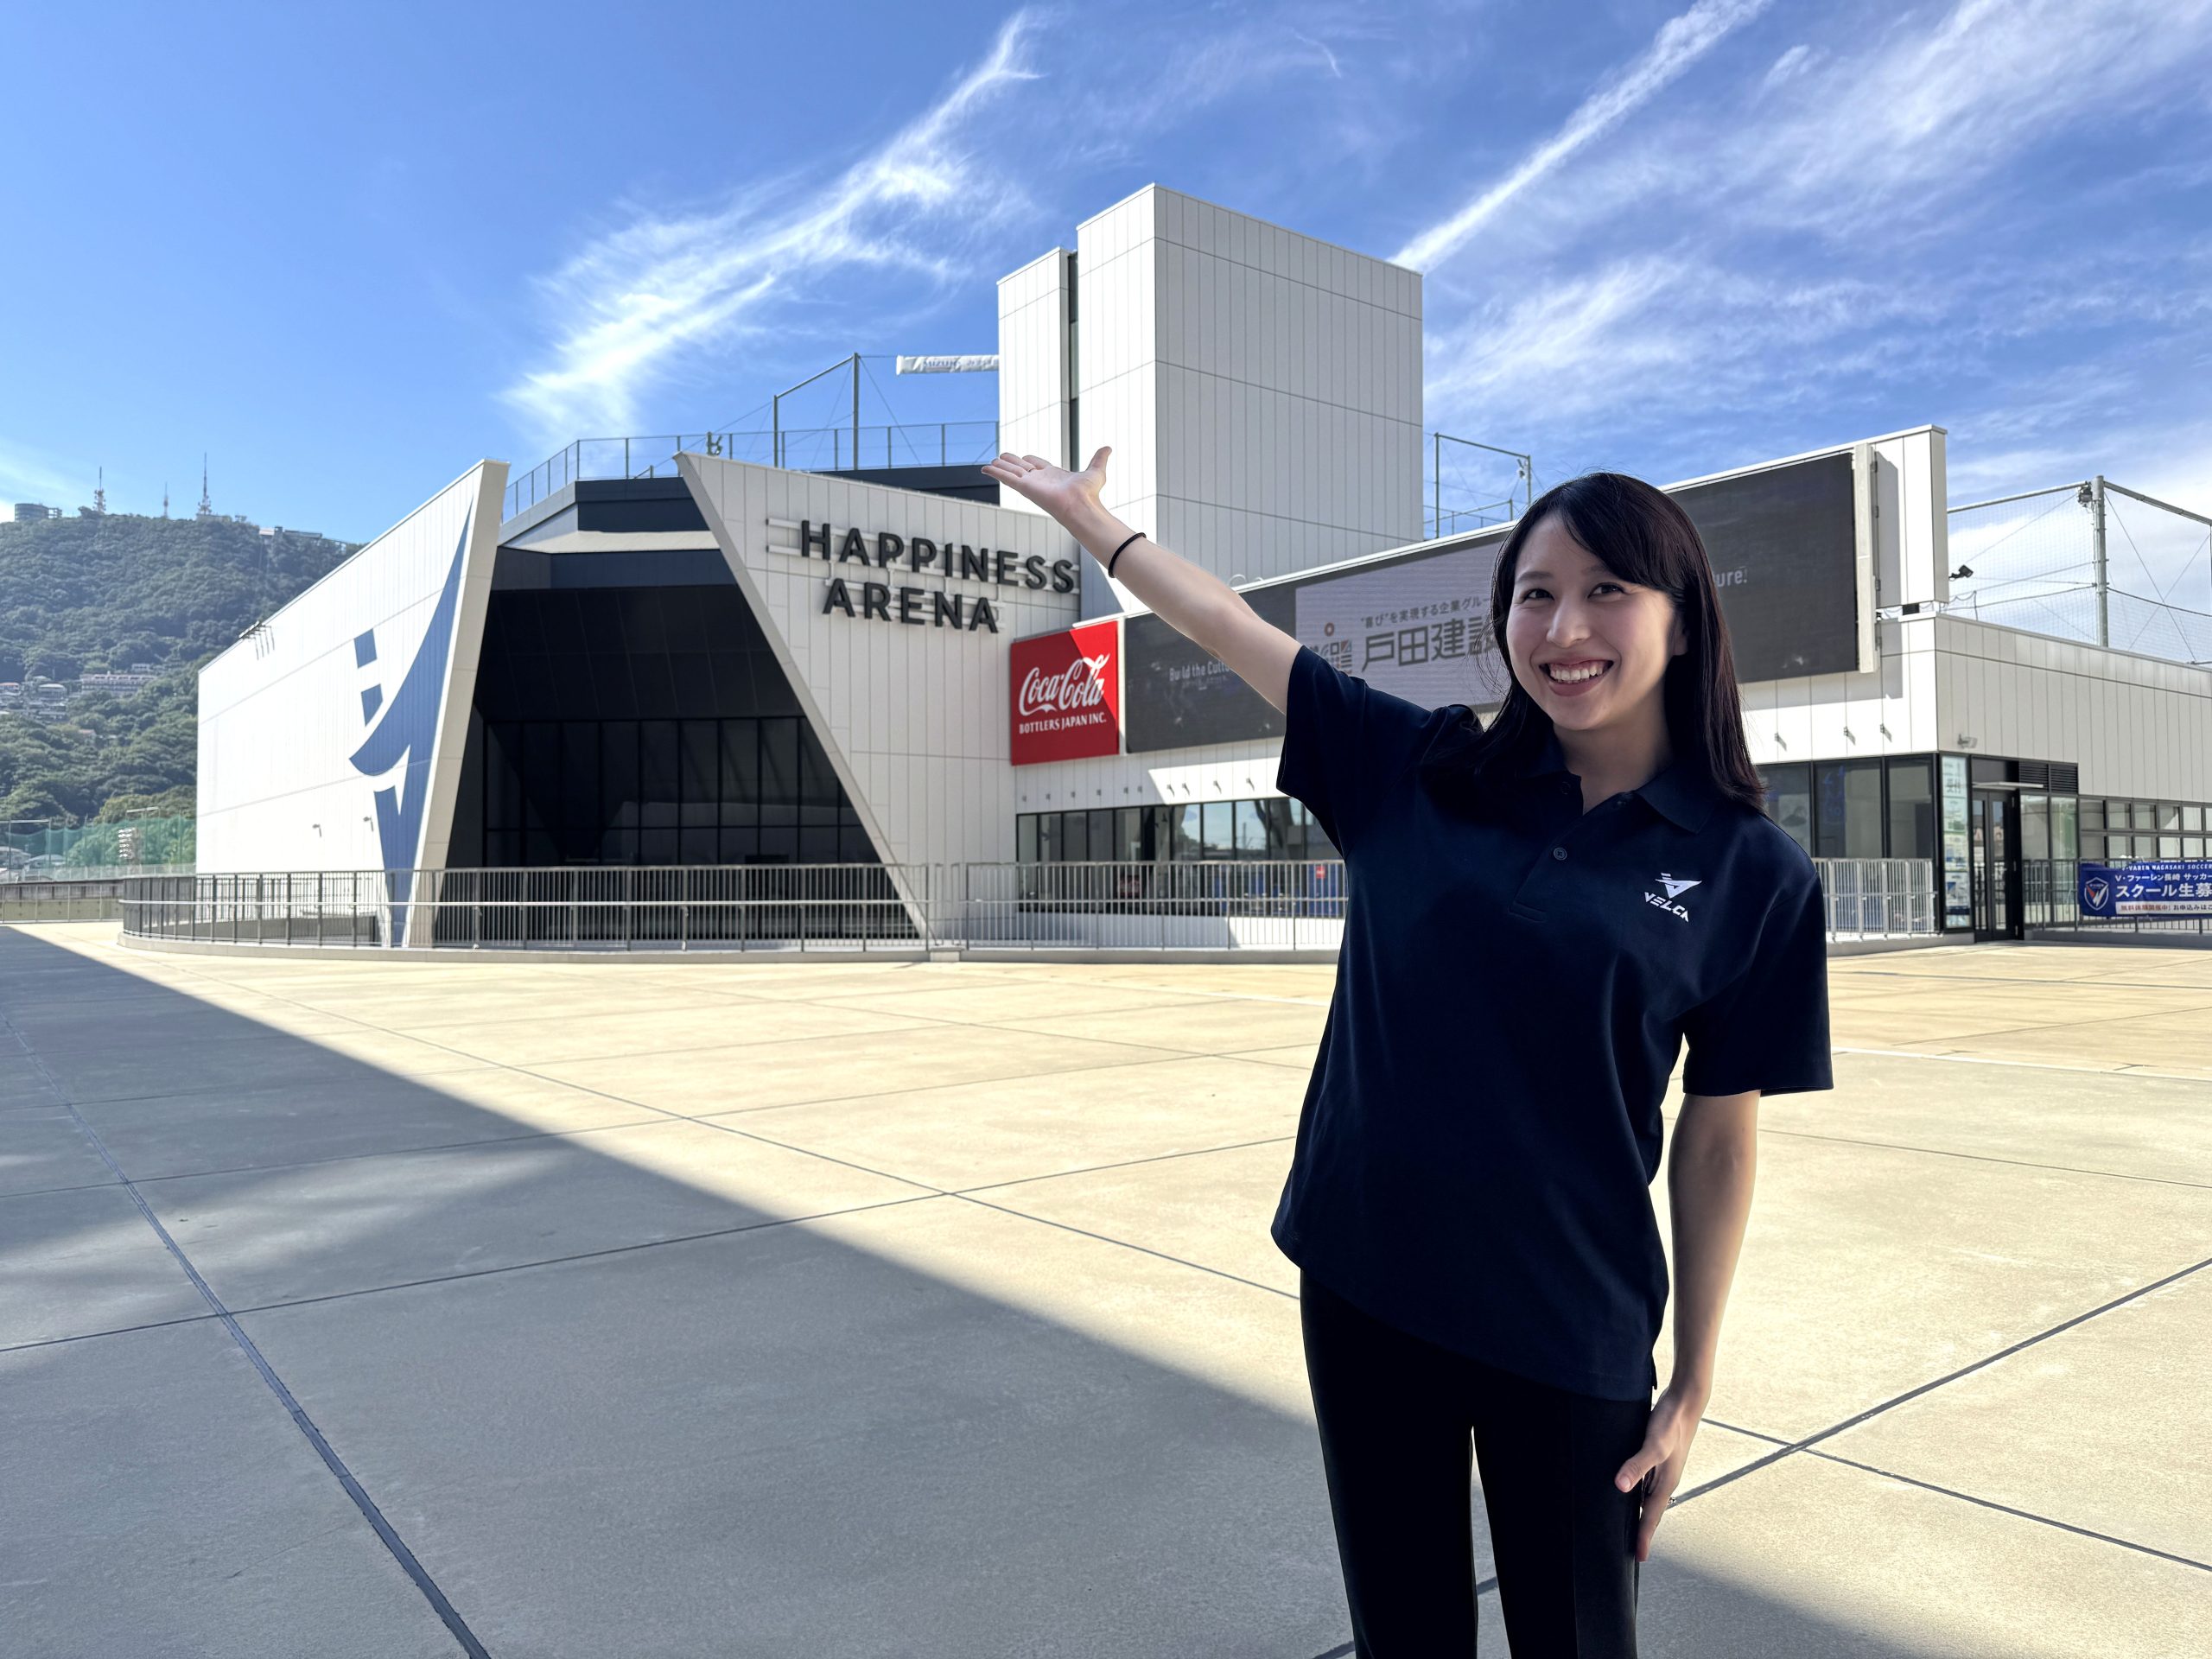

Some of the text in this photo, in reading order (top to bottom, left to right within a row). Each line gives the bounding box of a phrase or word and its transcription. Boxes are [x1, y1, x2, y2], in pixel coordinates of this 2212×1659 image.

[801, 519, 1075, 594] HAPPINESS
[823, 577, 999, 633] ARENA
[1019, 653, 1110, 716] Coca-Cola
[1169, 664, 1191, 682] Buld
[1192, 663, 1206, 677] the
[1019, 711, 1107, 734] BOTTLERS JAPAN INC.
[2115, 882, 2212, 899] スクール生募
[1644, 891, 1689, 923] VELCA
